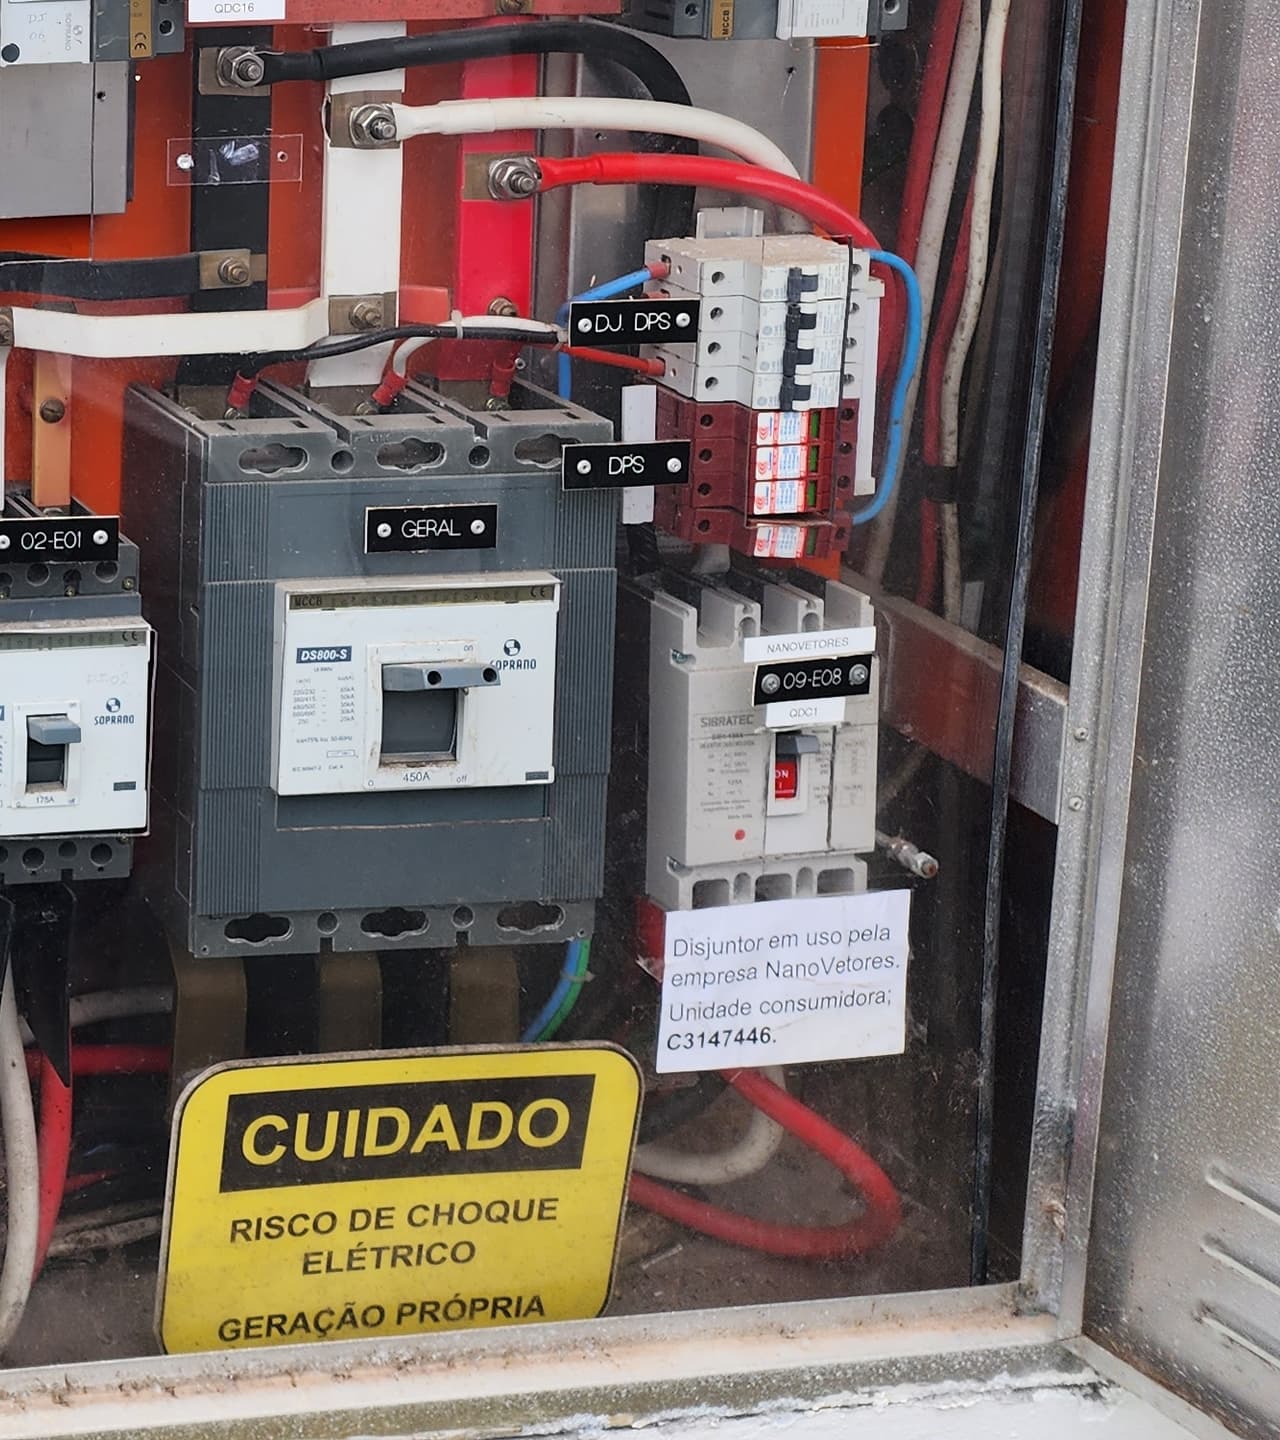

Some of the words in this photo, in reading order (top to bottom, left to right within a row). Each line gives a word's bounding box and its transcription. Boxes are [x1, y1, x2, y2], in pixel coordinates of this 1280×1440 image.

[214, 2, 255, 15] QDC16
[595, 315, 624, 332] DJ.
[634, 312, 671, 330] DPS
[608, 456, 645, 475] DPS
[401, 519, 461, 539] GERAL
[20, 531, 82, 550] 02-E01
[294, 596, 322, 608] MCCB
[301, 648, 348, 661] DS800-S
[767, 636, 850, 654] NANOVETORES
[782, 667, 843, 690] 09-E08
[94, 714, 135, 725] SOPRANO
[700, 714, 754, 728] SIBRATEC
[789, 707, 819, 719] QDC1
[402, 771, 431, 783] 450A
[672, 934, 765, 961] Disjuntor
[769, 932, 800, 949] em
[806, 927, 843, 947] uso
[847, 923, 891, 949] pela
[670, 966, 758, 991] empresa
[765, 954, 901, 980] NanoVetores.
[668, 998, 752, 1022] Unidade
[758, 989, 893, 1015] consumidora;
[666, 1026, 778, 1051] C3147446.
[241, 1098, 571, 1166] CUIDADO
[230, 1210, 338, 1243] RISCO
[349, 1207, 395, 1232] DE
[406, 1198, 559, 1229] CHOQUE
[302, 1240, 476, 1276] ELÉTRICO
[217, 1303, 386, 1343] GERAÇÃO
[396, 1292, 546, 1327] PRÓPRIA
